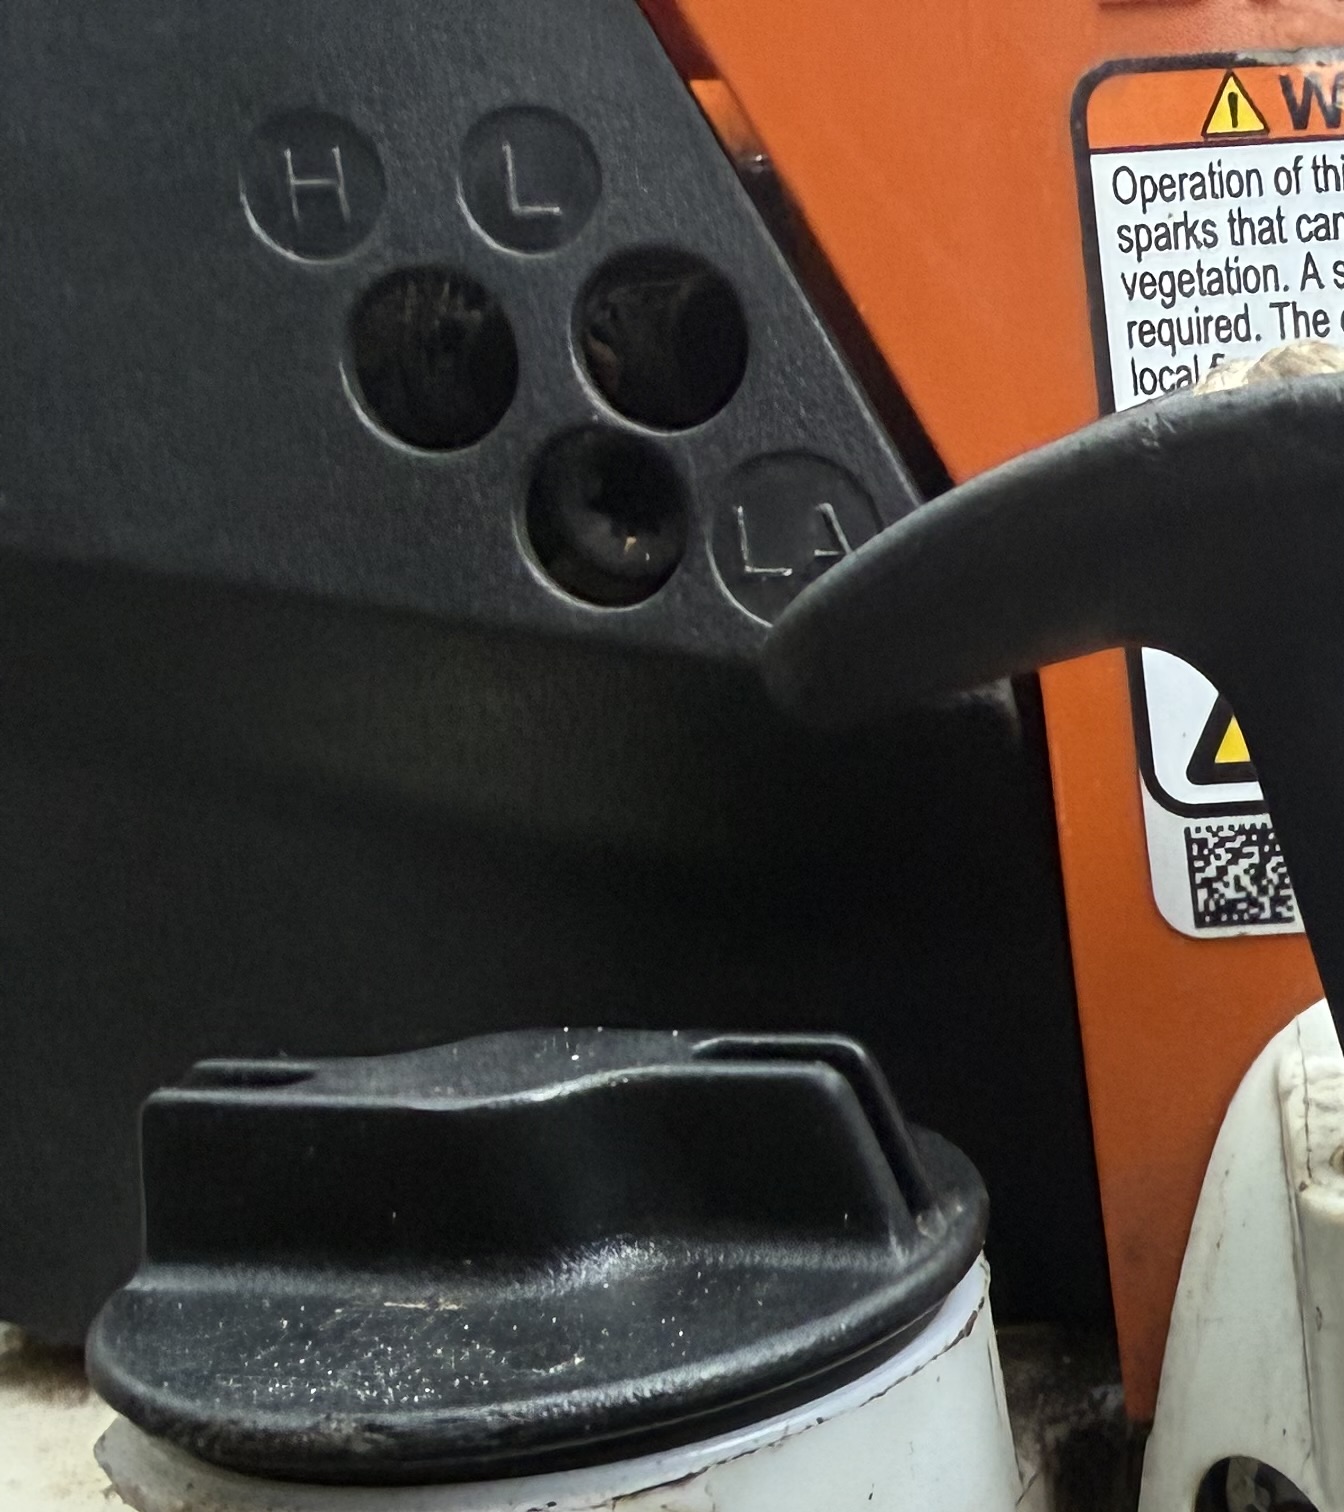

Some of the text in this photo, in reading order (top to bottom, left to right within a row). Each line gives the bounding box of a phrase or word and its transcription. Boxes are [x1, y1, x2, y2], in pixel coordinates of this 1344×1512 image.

[282, 145, 352, 223] H
[502, 141, 562, 216] L
[1112, 158, 1264, 214] Operation
[1273, 154, 1304, 196] of
[1117, 210, 1219, 262] sparks
[1228, 206, 1288, 246] that
[1120, 256, 1290, 310] vegetation.
[1300, 251, 1326, 291] A
[1127, 302, 1262, 357] required.
[1269, 300, 1331, 340] The
[1130, 353, 1200, 396] local
